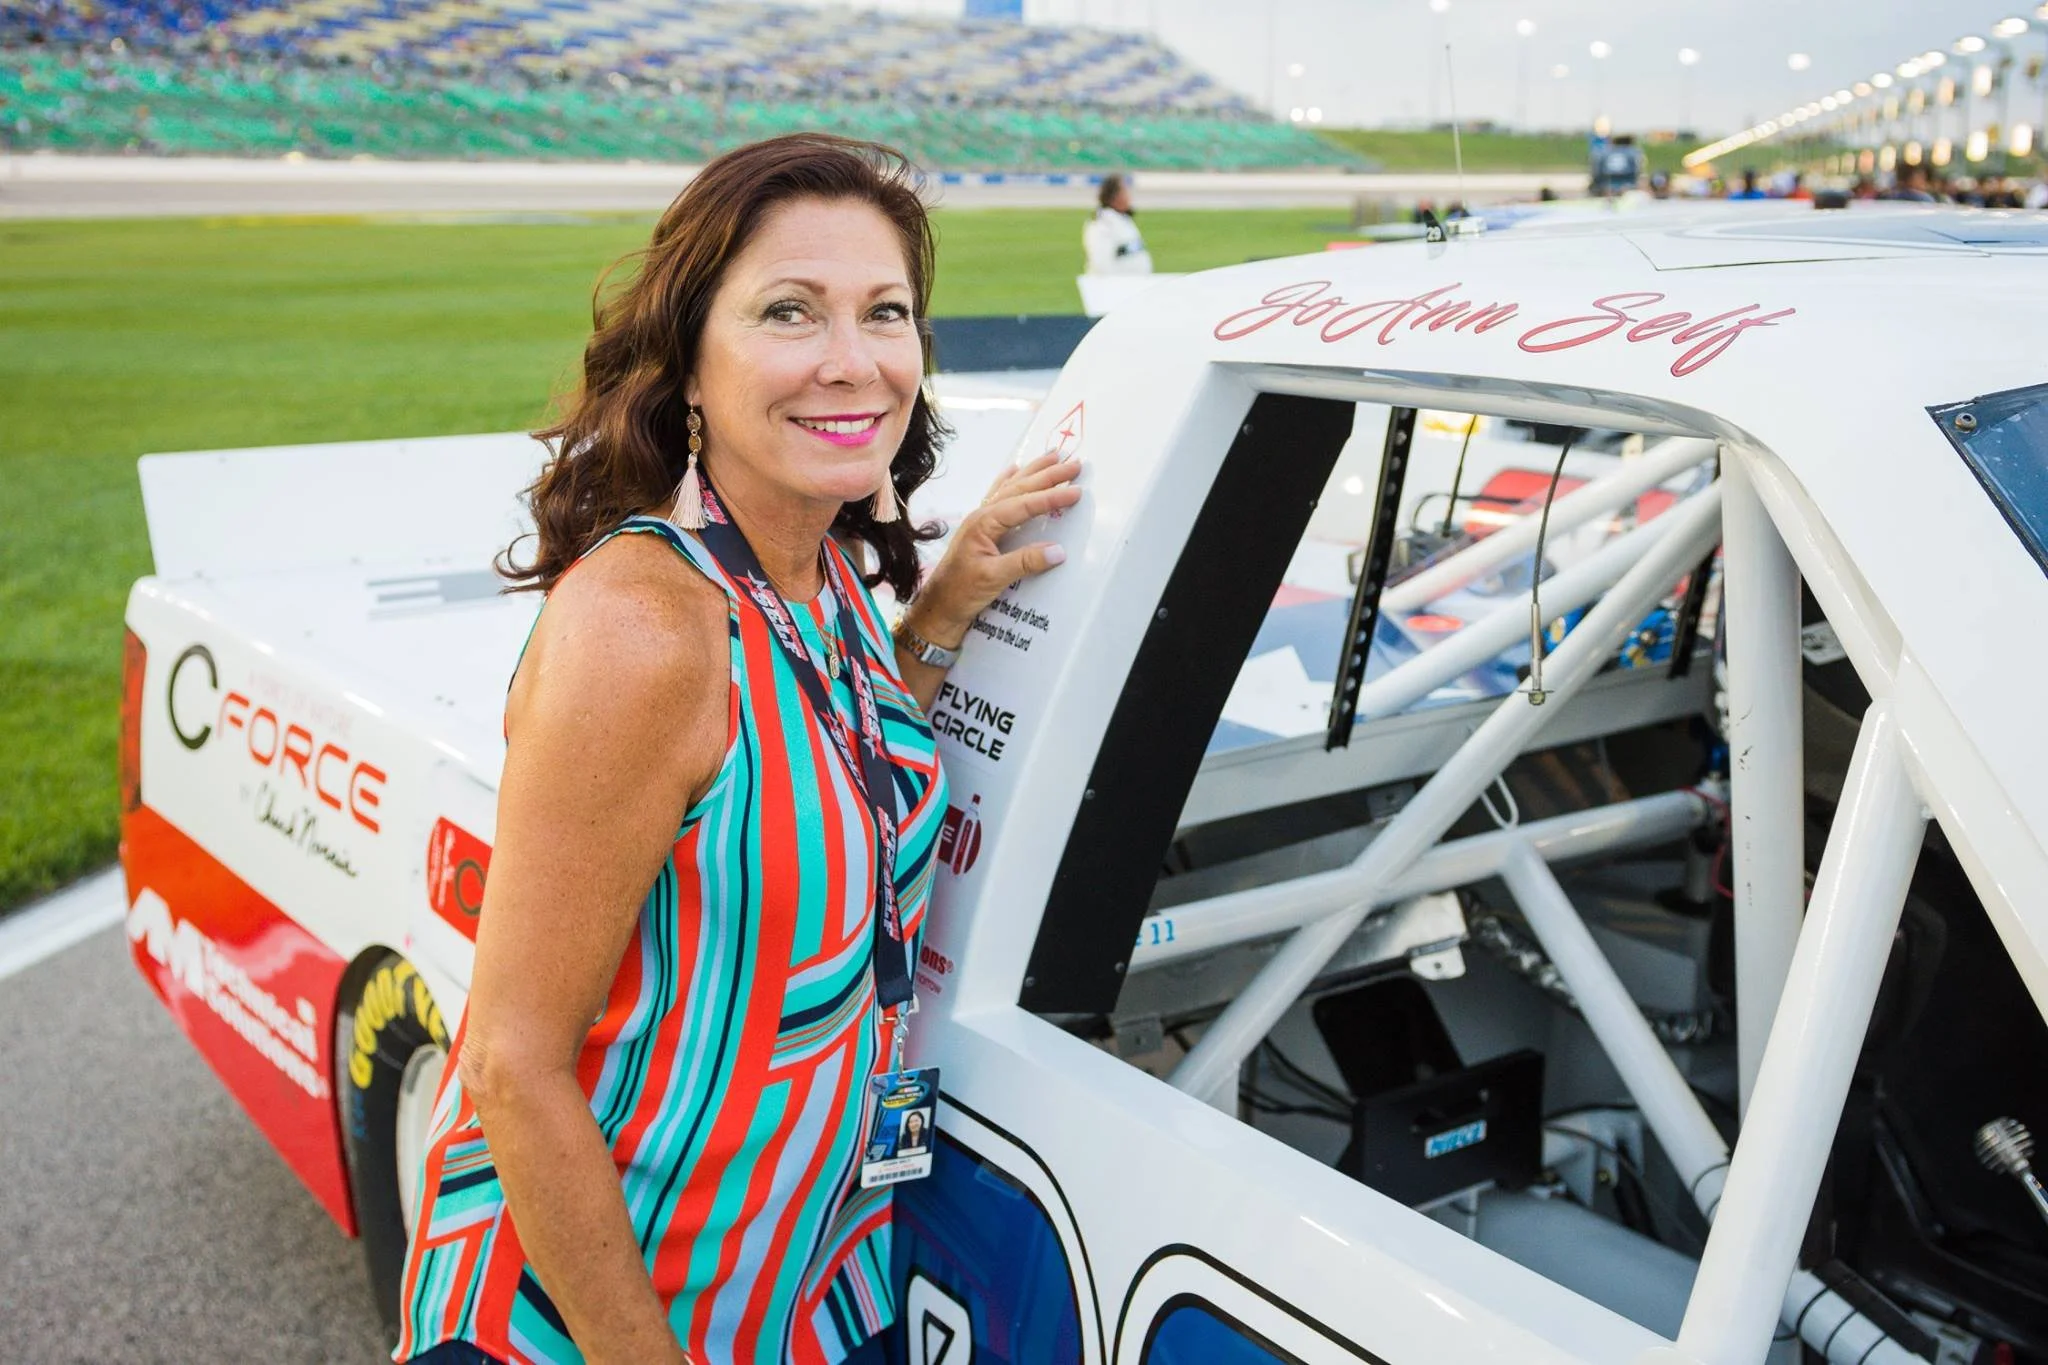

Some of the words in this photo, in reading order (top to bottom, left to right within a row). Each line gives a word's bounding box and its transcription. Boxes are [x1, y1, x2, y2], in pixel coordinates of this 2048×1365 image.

[1517, 292, 1796, 377] Self
[996, 625, 1005, 641] to
[1003, 628, 1016, 646] the
[1014, 631, 1033, 652] Lord
[1009, 602, 1023, 624] day
[1021, 608, 1034, 622] of
[938, 681, 1016, 736] FLYING
[215, 691, 388, 835] FORCE
[931, 711, 1006, 762] CIRCLE
